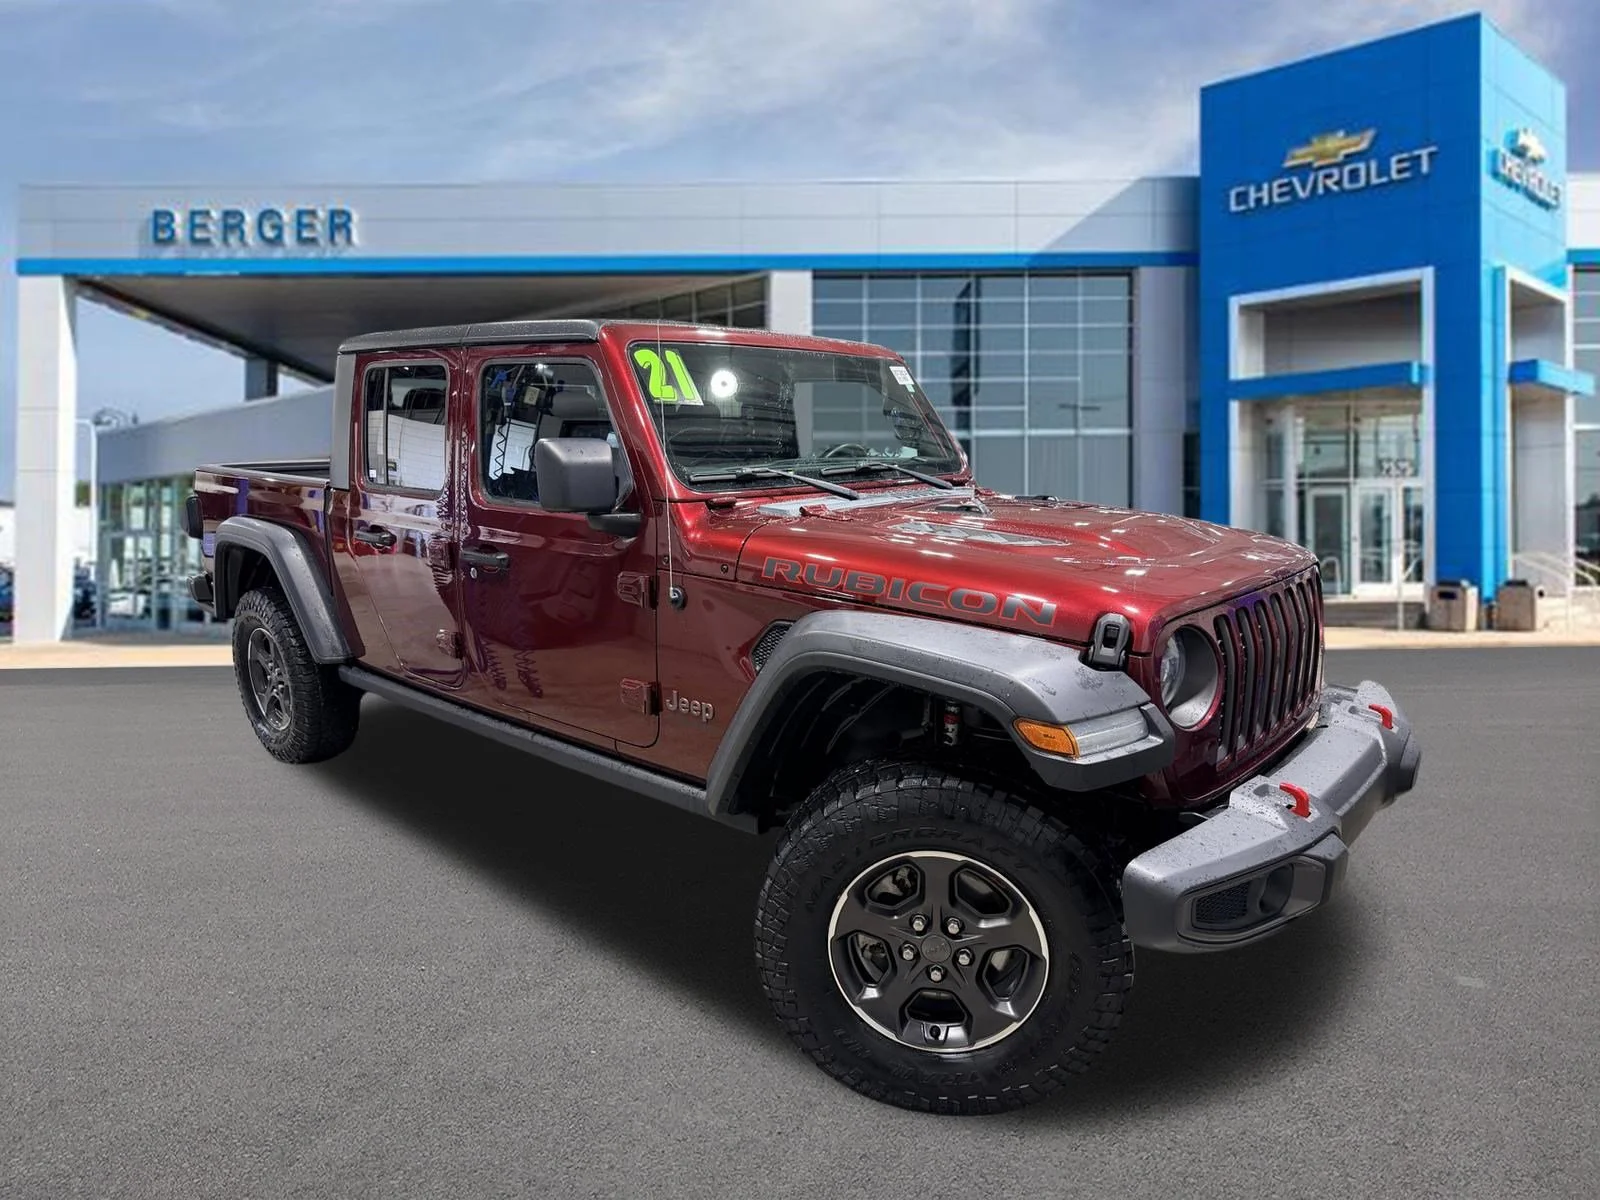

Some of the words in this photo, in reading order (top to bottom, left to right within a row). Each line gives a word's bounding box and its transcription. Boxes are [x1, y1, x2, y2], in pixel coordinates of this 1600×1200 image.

[1229, 146, 1438, 213] CHEVROLET
[152, 207, 355, 246] BERGER
[633, 348, 704, 406] 21
[761, 556, 1058, 628] RUBICON
[665, 690, 714, 722] Jeep
